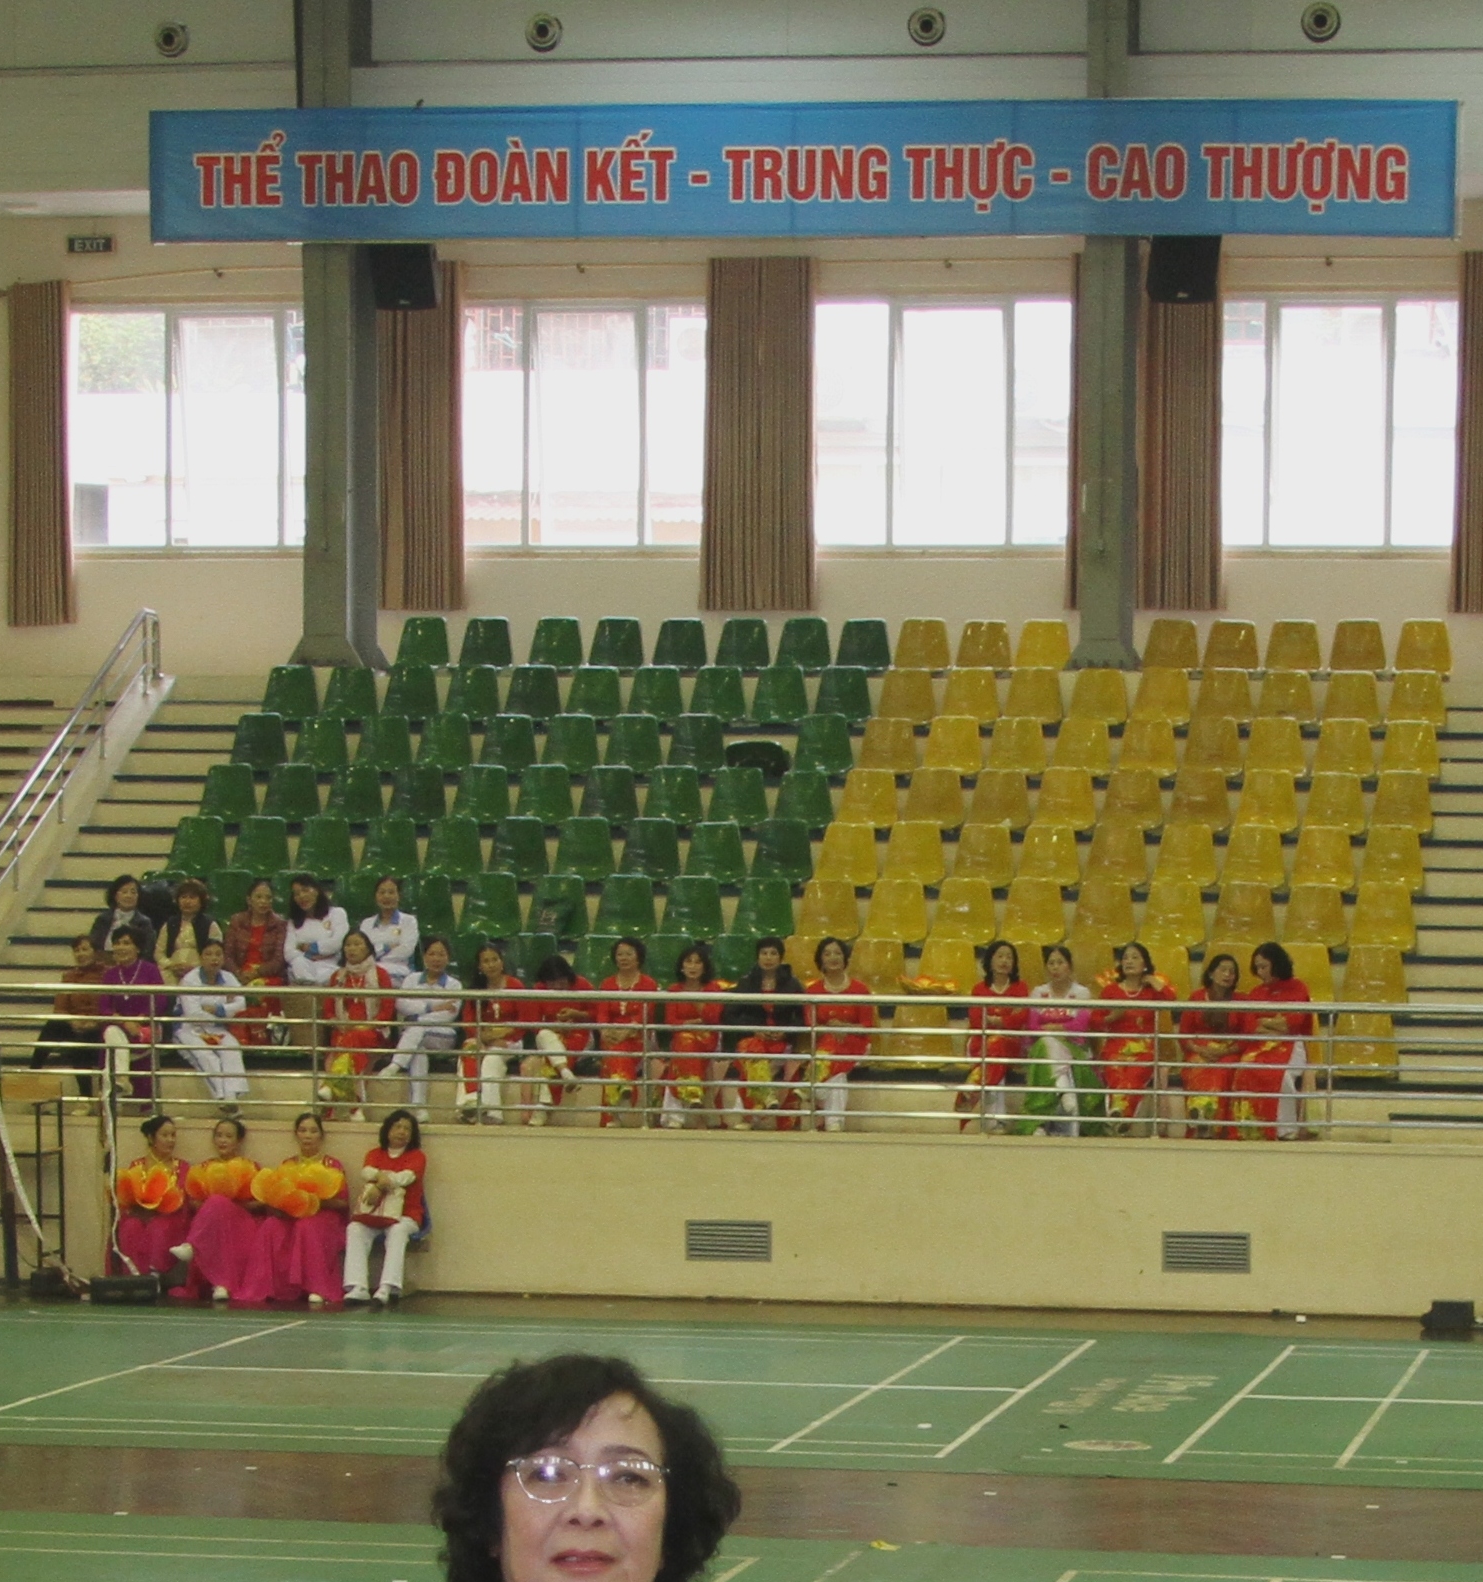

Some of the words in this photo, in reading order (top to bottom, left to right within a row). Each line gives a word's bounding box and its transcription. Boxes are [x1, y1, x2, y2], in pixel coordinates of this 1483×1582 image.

[194, 130, 287, 207] THỂ
[296, 150, 419, 207] THAO
[433, 138, 570, 206] ĐOÀN
[584, 130, 677, 204] KẾT
[689, 170, 709, 186] -
[723, 144, 889, 203] TRUNG
[903, 139, 1035, 213] THỰC
[1050, 168, 1071, 184] -
[1085, 144, 1188, 201] CAO
[1202, 138, 1409, 214] THƯỢNG
[74, 239, 106, 252] EXIT
